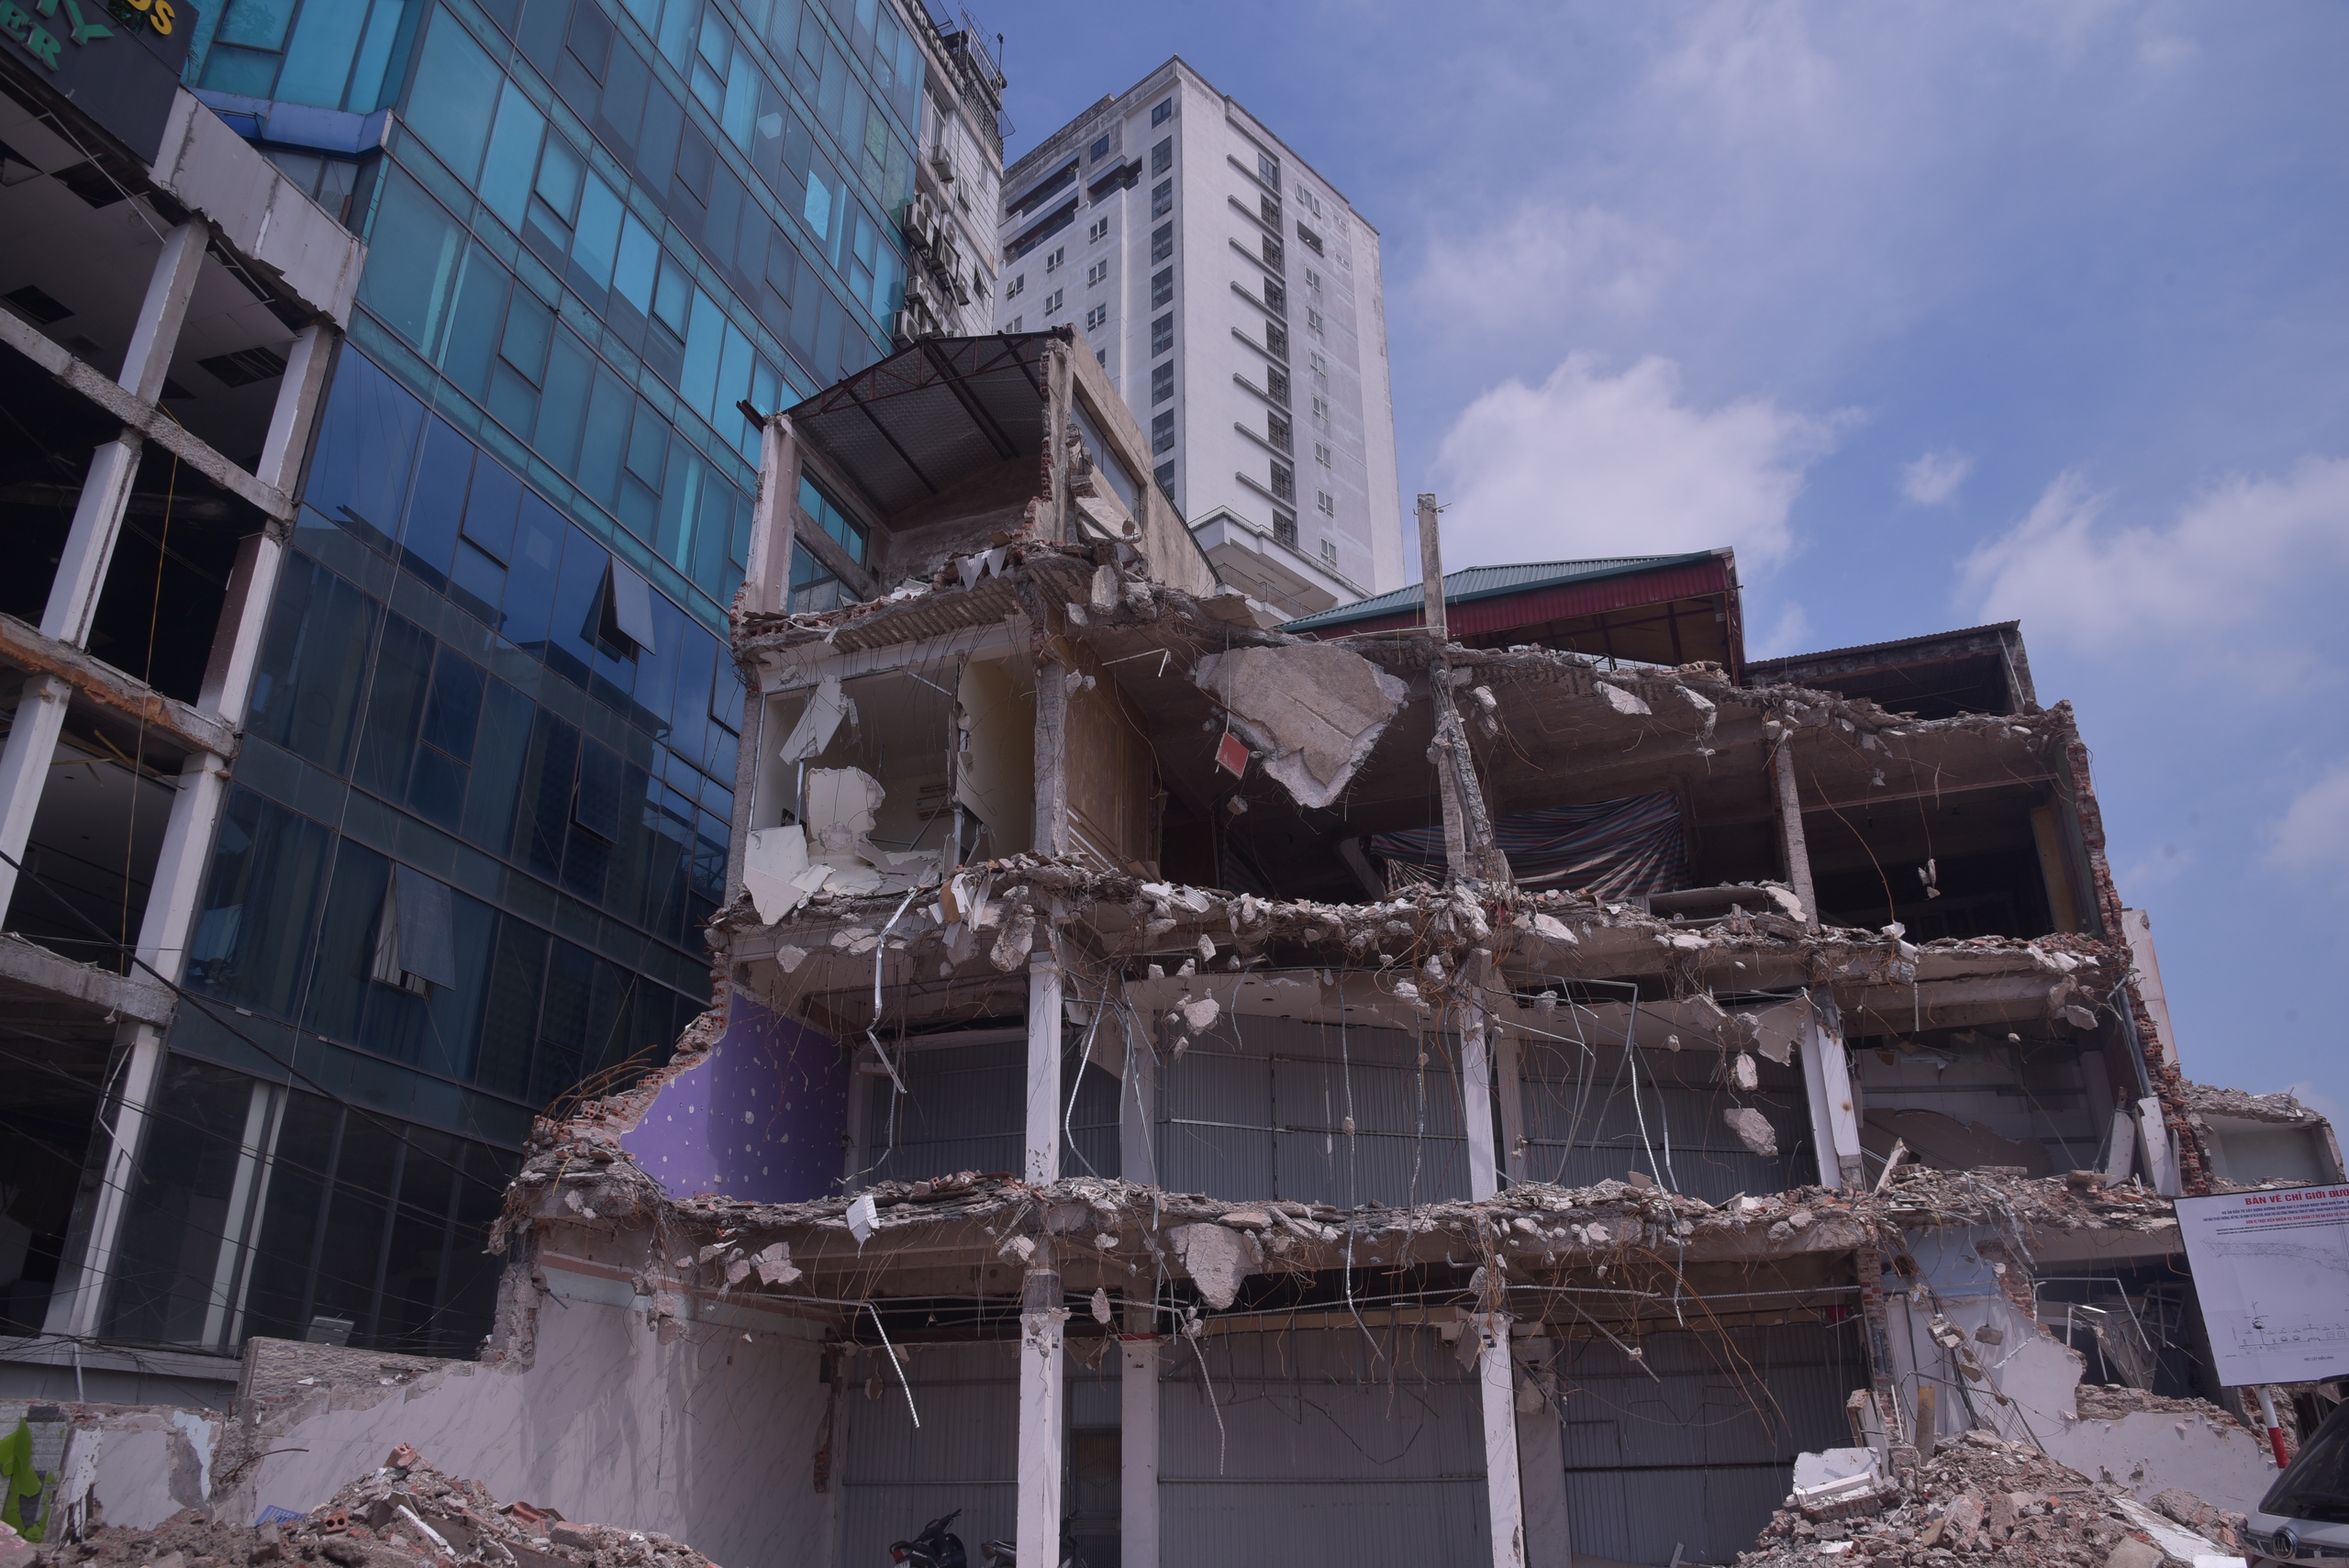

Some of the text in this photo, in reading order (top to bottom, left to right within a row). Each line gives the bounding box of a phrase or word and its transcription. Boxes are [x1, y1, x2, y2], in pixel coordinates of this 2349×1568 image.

[930, 28, 966, 91] COFFEE
[2244, 1195, 2267, 1206] BẢN
[2285, 1191, 2302, 1202] CHỈ
[2305, 1190, 2326, 1200] GIỚI
[2273, 1537, 2288, 1552] KIA
